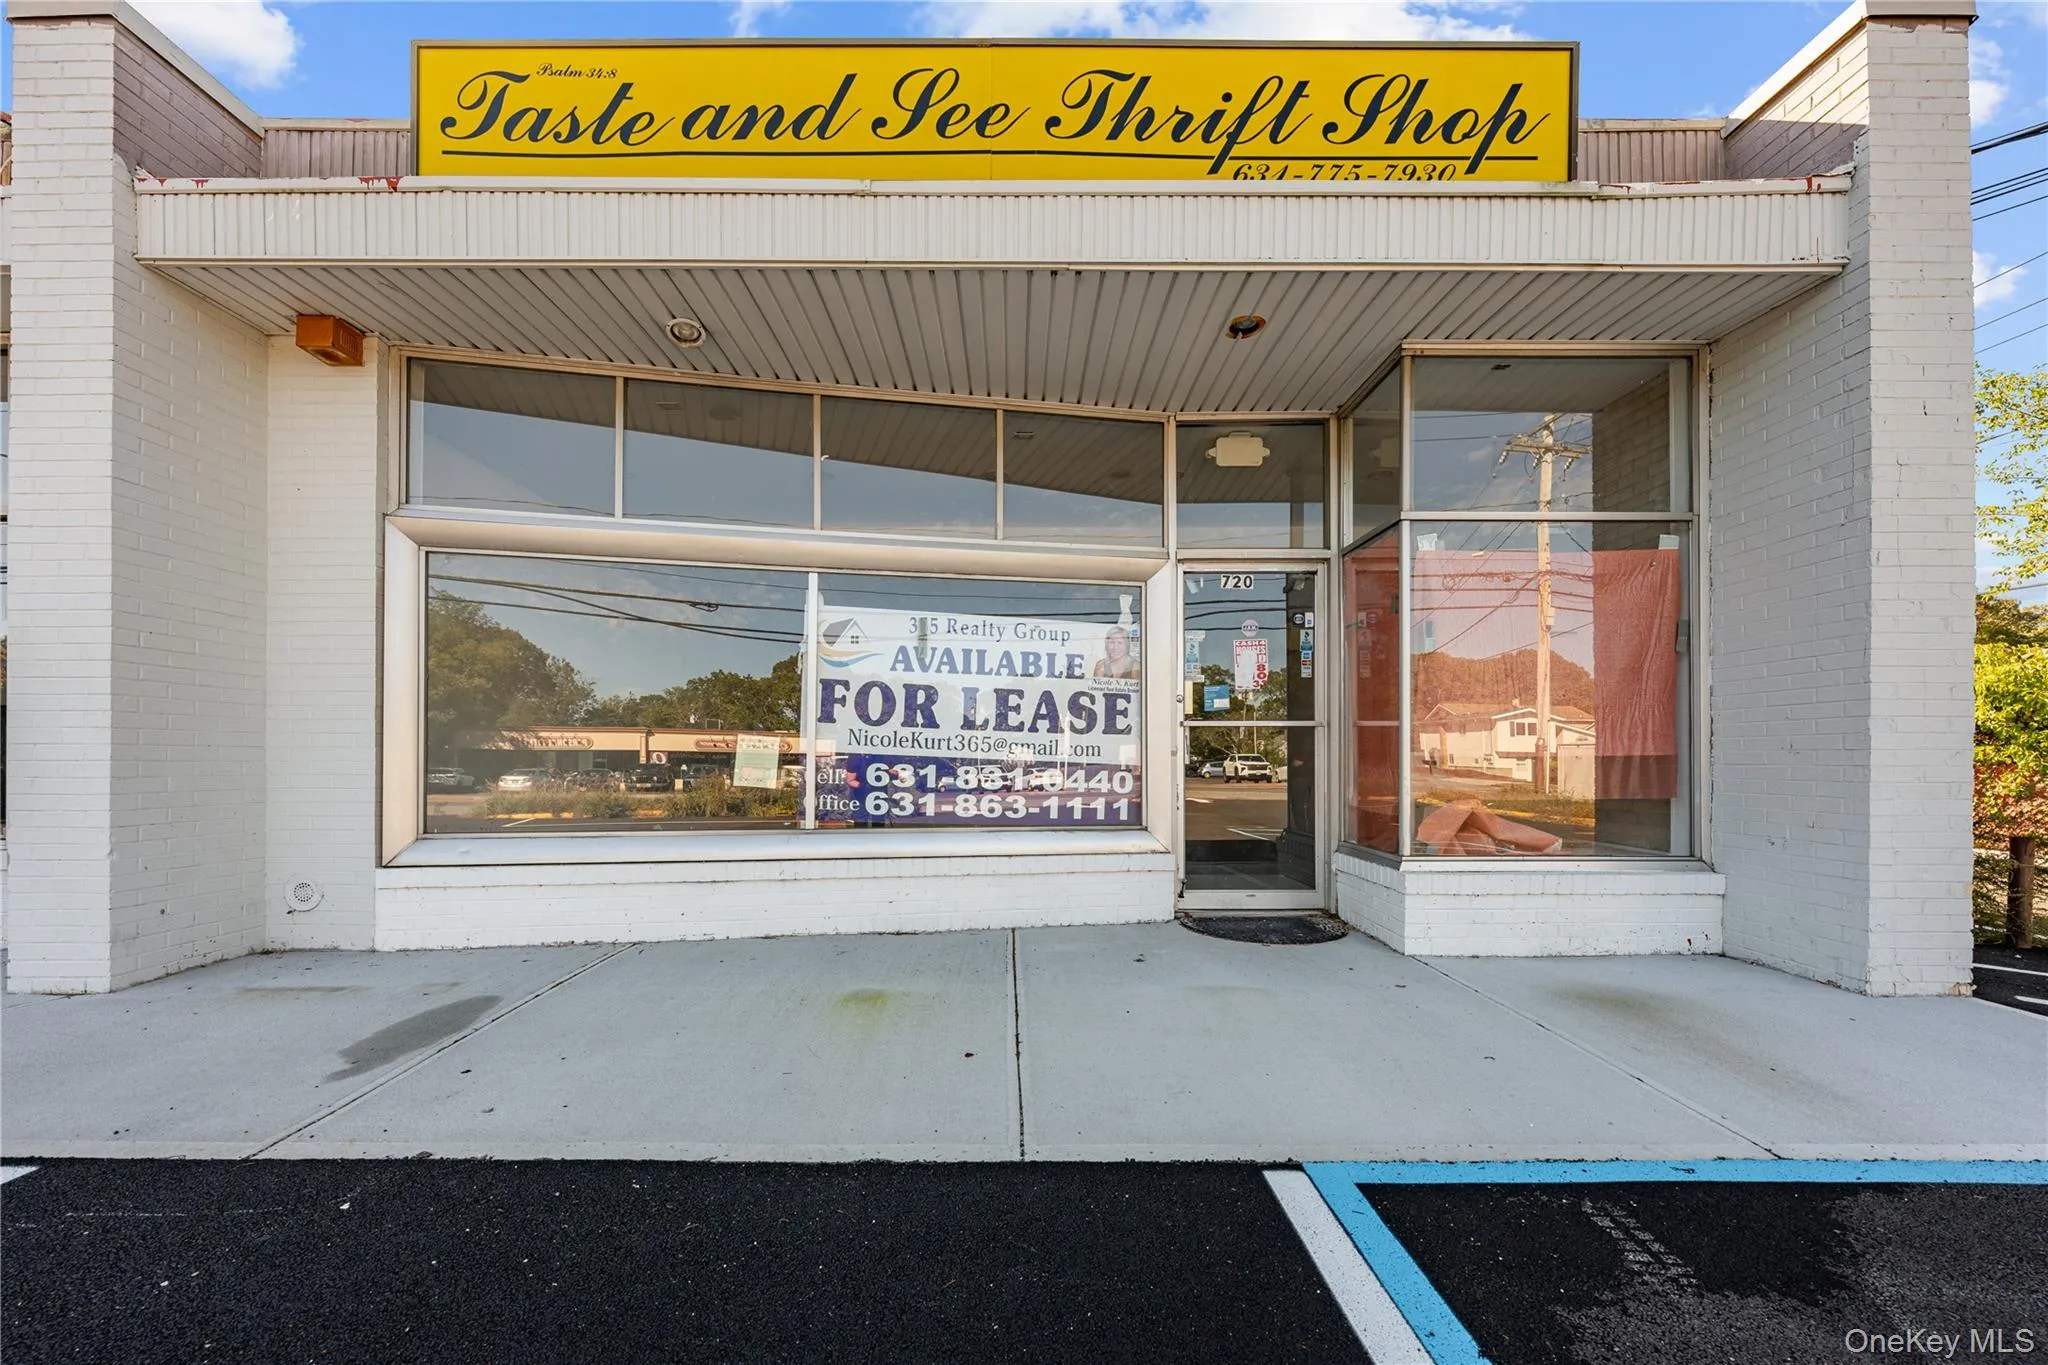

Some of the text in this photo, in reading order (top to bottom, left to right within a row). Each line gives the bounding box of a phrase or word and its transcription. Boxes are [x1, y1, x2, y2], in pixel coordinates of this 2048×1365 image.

[536, 62, 618, 79] Psalm 34:8
[440, 67, 1552, 175] Taste and See Thrift Shop
[1221, 575, 1253, 589] 720
[908, 616, 1072, 647] 35 Realty Group
[889, 644, 1086, 680] AVAILABLE
[817, 678, 1133, 736] FOR LEASE
[804, 768, 845, 785] ell:
[803, 792, 1129, 820] ffice 631-863-1111
